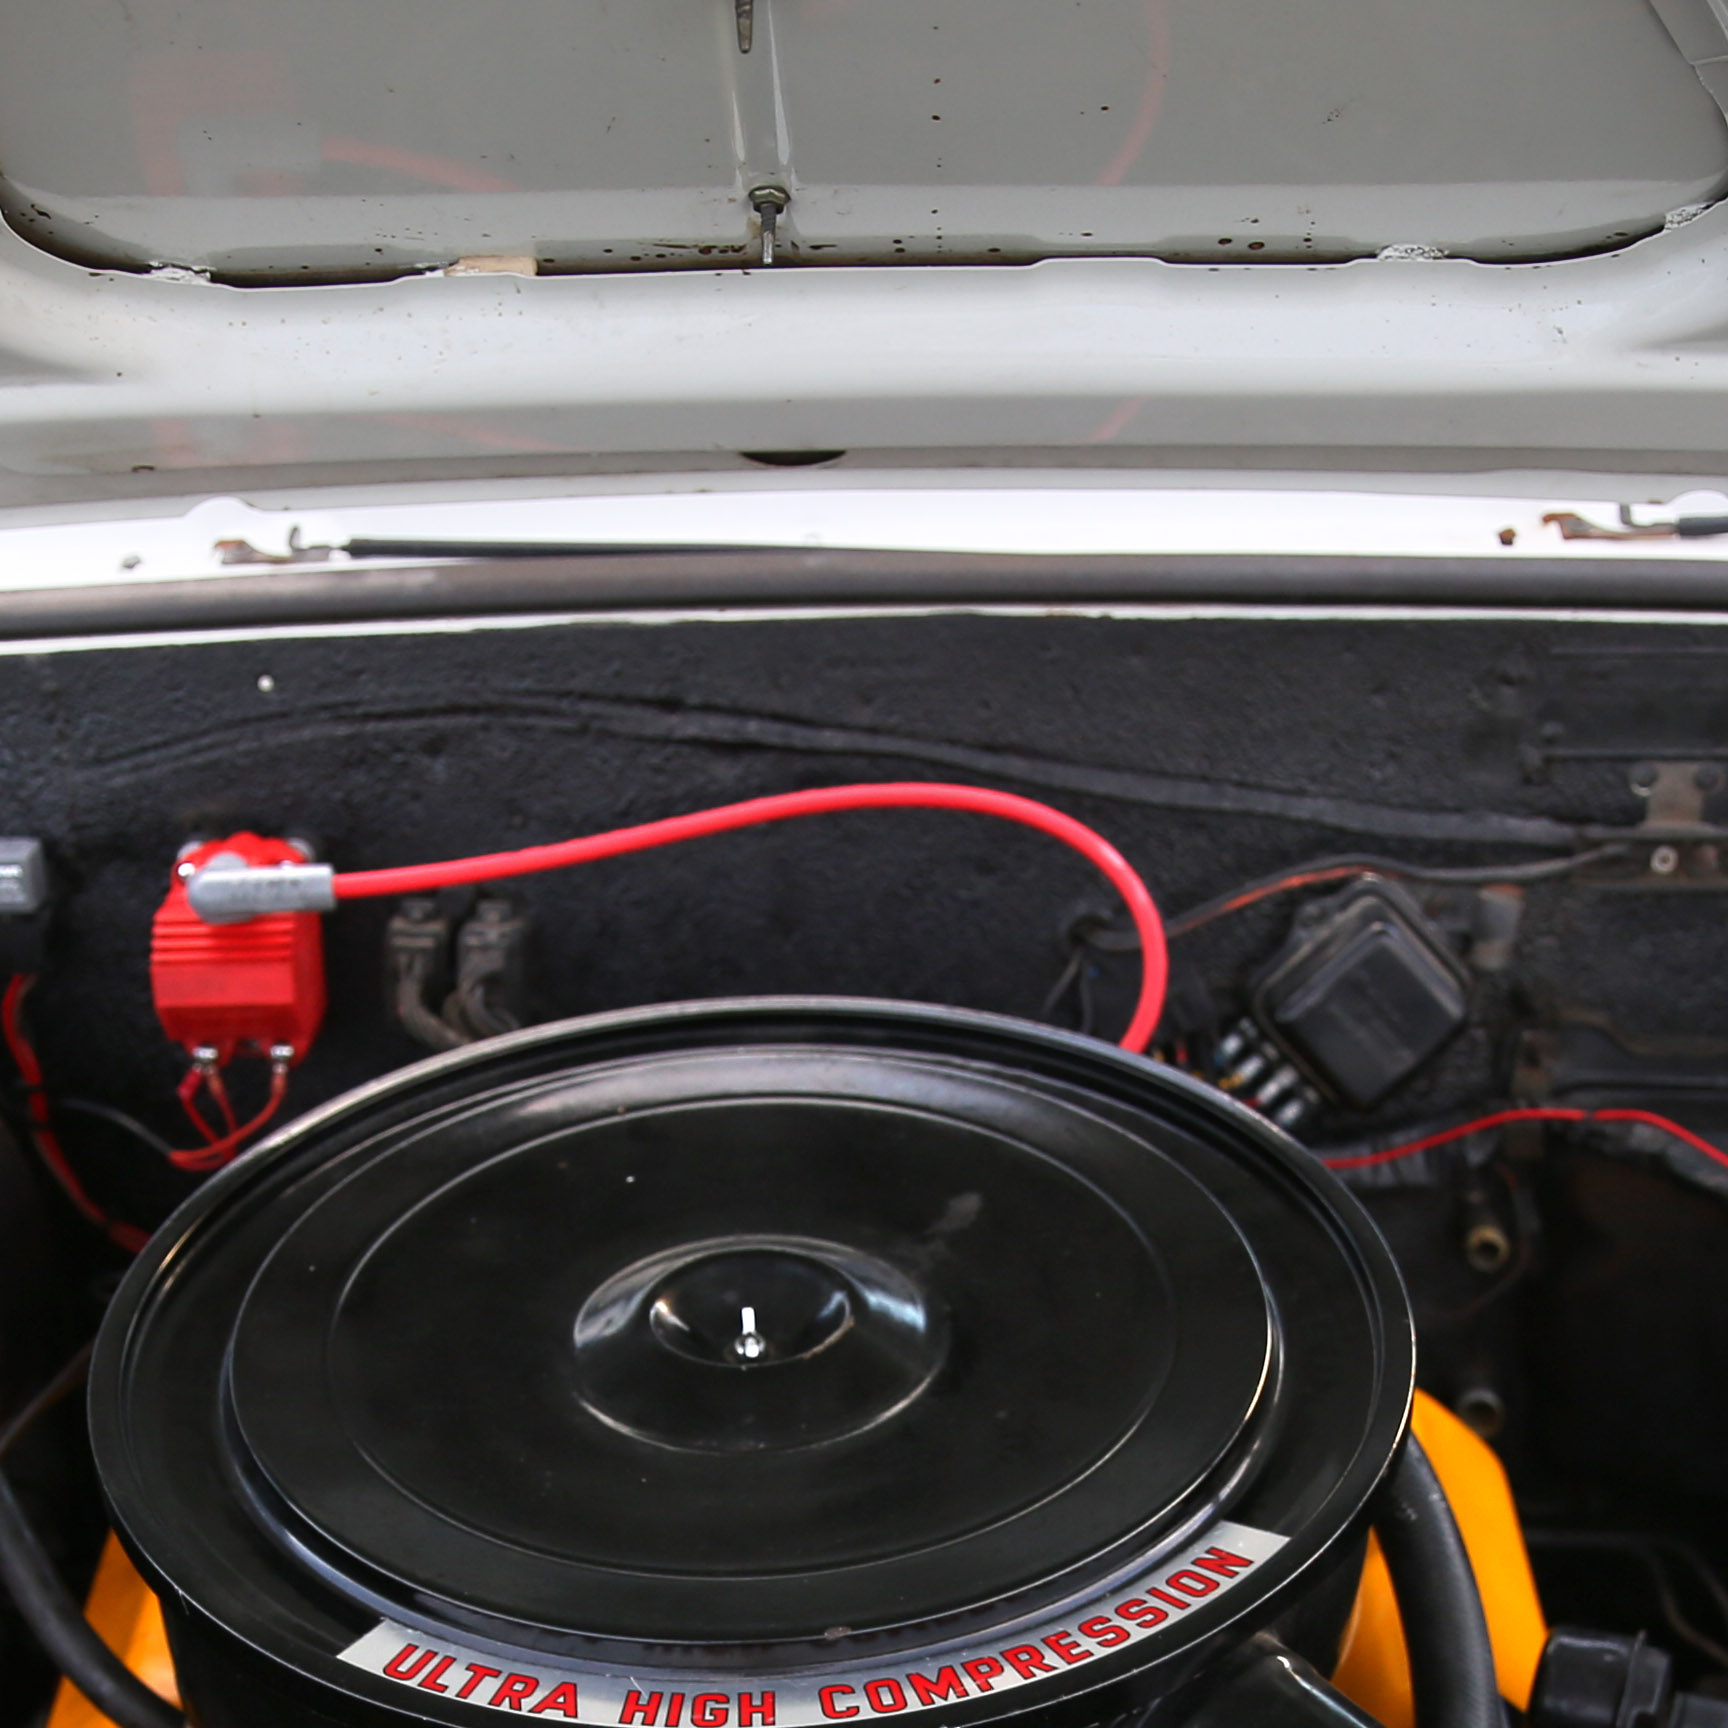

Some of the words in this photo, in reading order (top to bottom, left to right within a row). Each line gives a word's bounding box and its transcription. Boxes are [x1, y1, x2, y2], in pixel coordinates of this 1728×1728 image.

[384, 1644, 579, 1718] ULTRA
[620, 1689, 776, 1728] HIGH
[818, 1547, 1252, 1720] COMPRESSION
